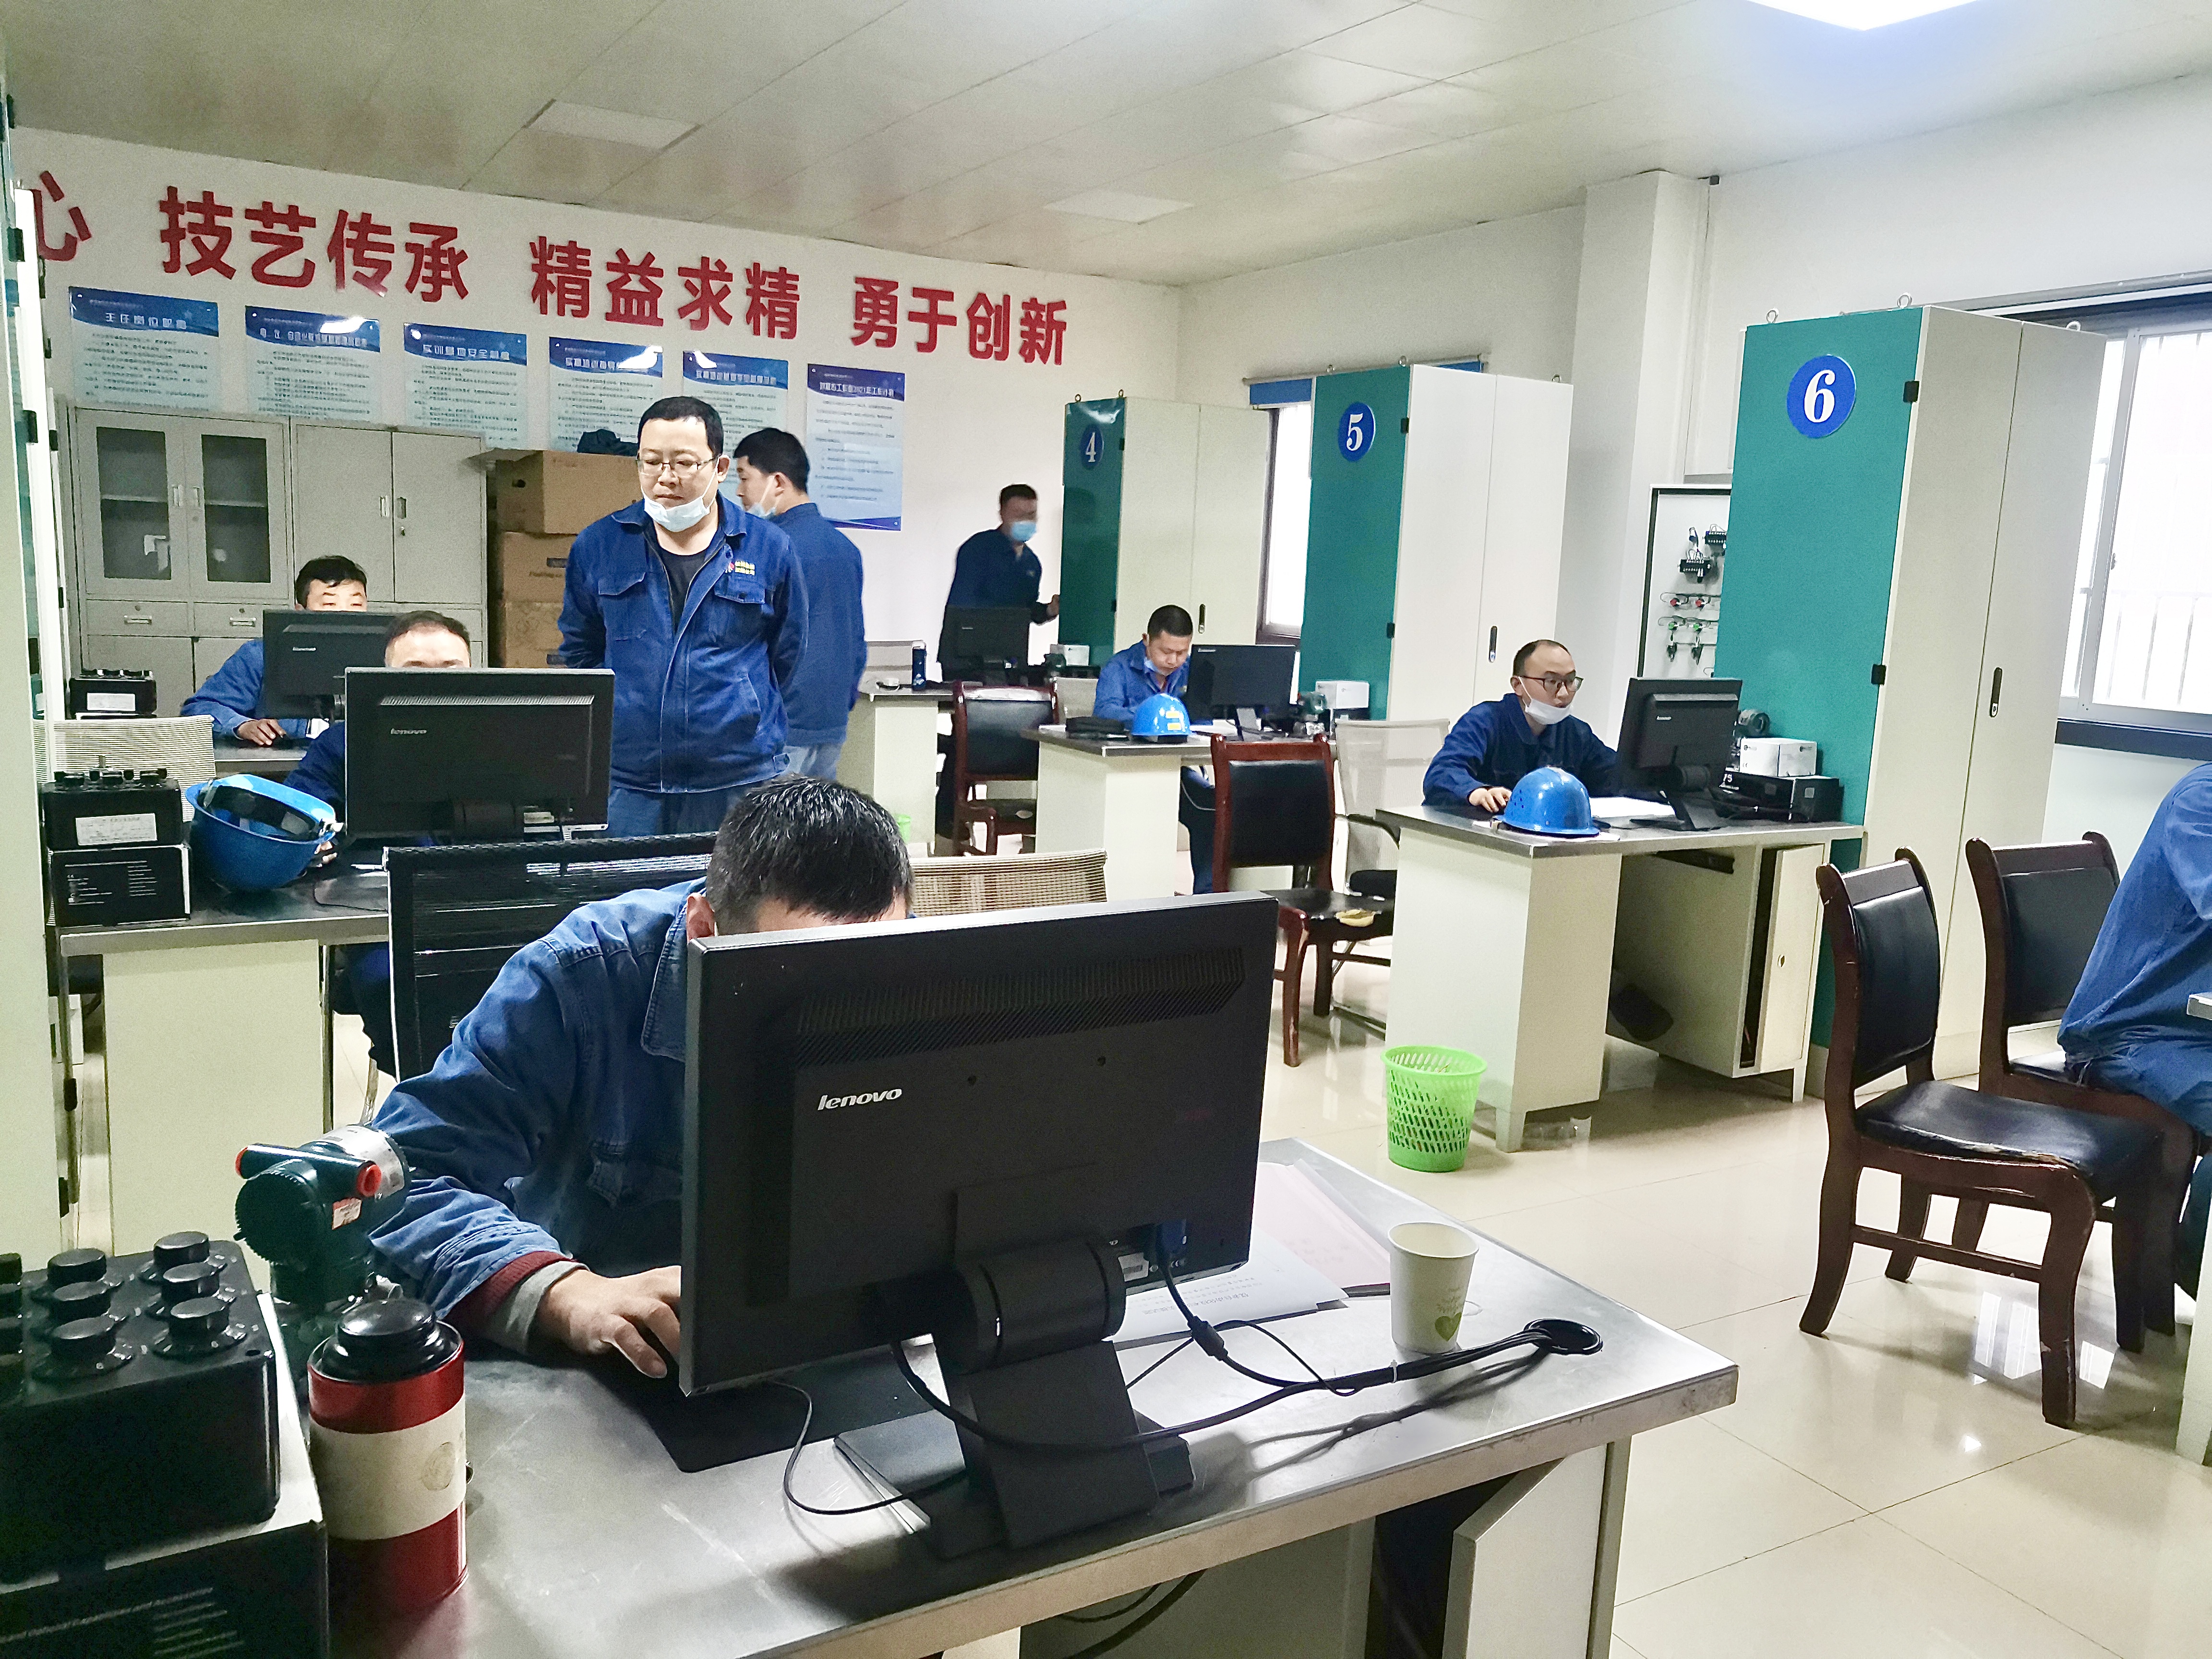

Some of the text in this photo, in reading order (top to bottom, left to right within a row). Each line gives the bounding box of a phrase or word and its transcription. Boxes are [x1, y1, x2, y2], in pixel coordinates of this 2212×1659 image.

[29, 170, 1067, 366] 心 技艺传承 精益求精 勇于创新
[1803, 369, 1836, 423] 6
[1085, 432, 1097, 462] 4
[1346, 413, 1363, 452] 5
[817, 1088, 902, 1111] lenovo
